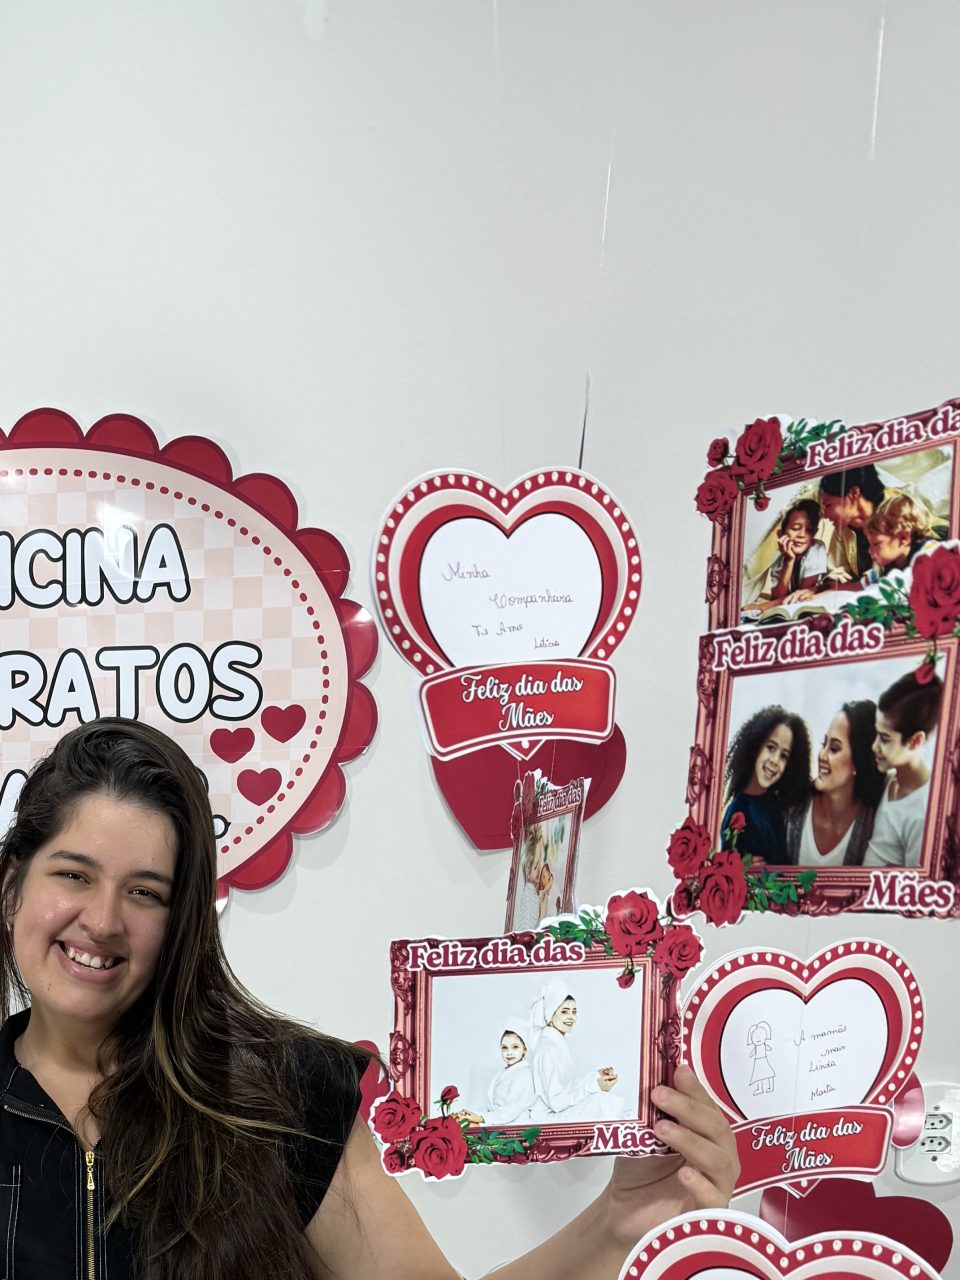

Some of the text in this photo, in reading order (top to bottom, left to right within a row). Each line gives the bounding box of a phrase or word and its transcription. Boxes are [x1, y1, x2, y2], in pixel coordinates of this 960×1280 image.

[806, 407, 960, 468] Feliz dia da
[714, 621, 883, 669] Feliz dia das
[460, 671, 583, 705] Feliz dia das
[499, 702, 555, 731] Mães
[866, 872, 953, 909] Mães
[408, 938, 584, 970] Feliz dia das
[751, 1117, 863, 1150] Feliz dia das
[782, 1147, 833, 1173] Mães
